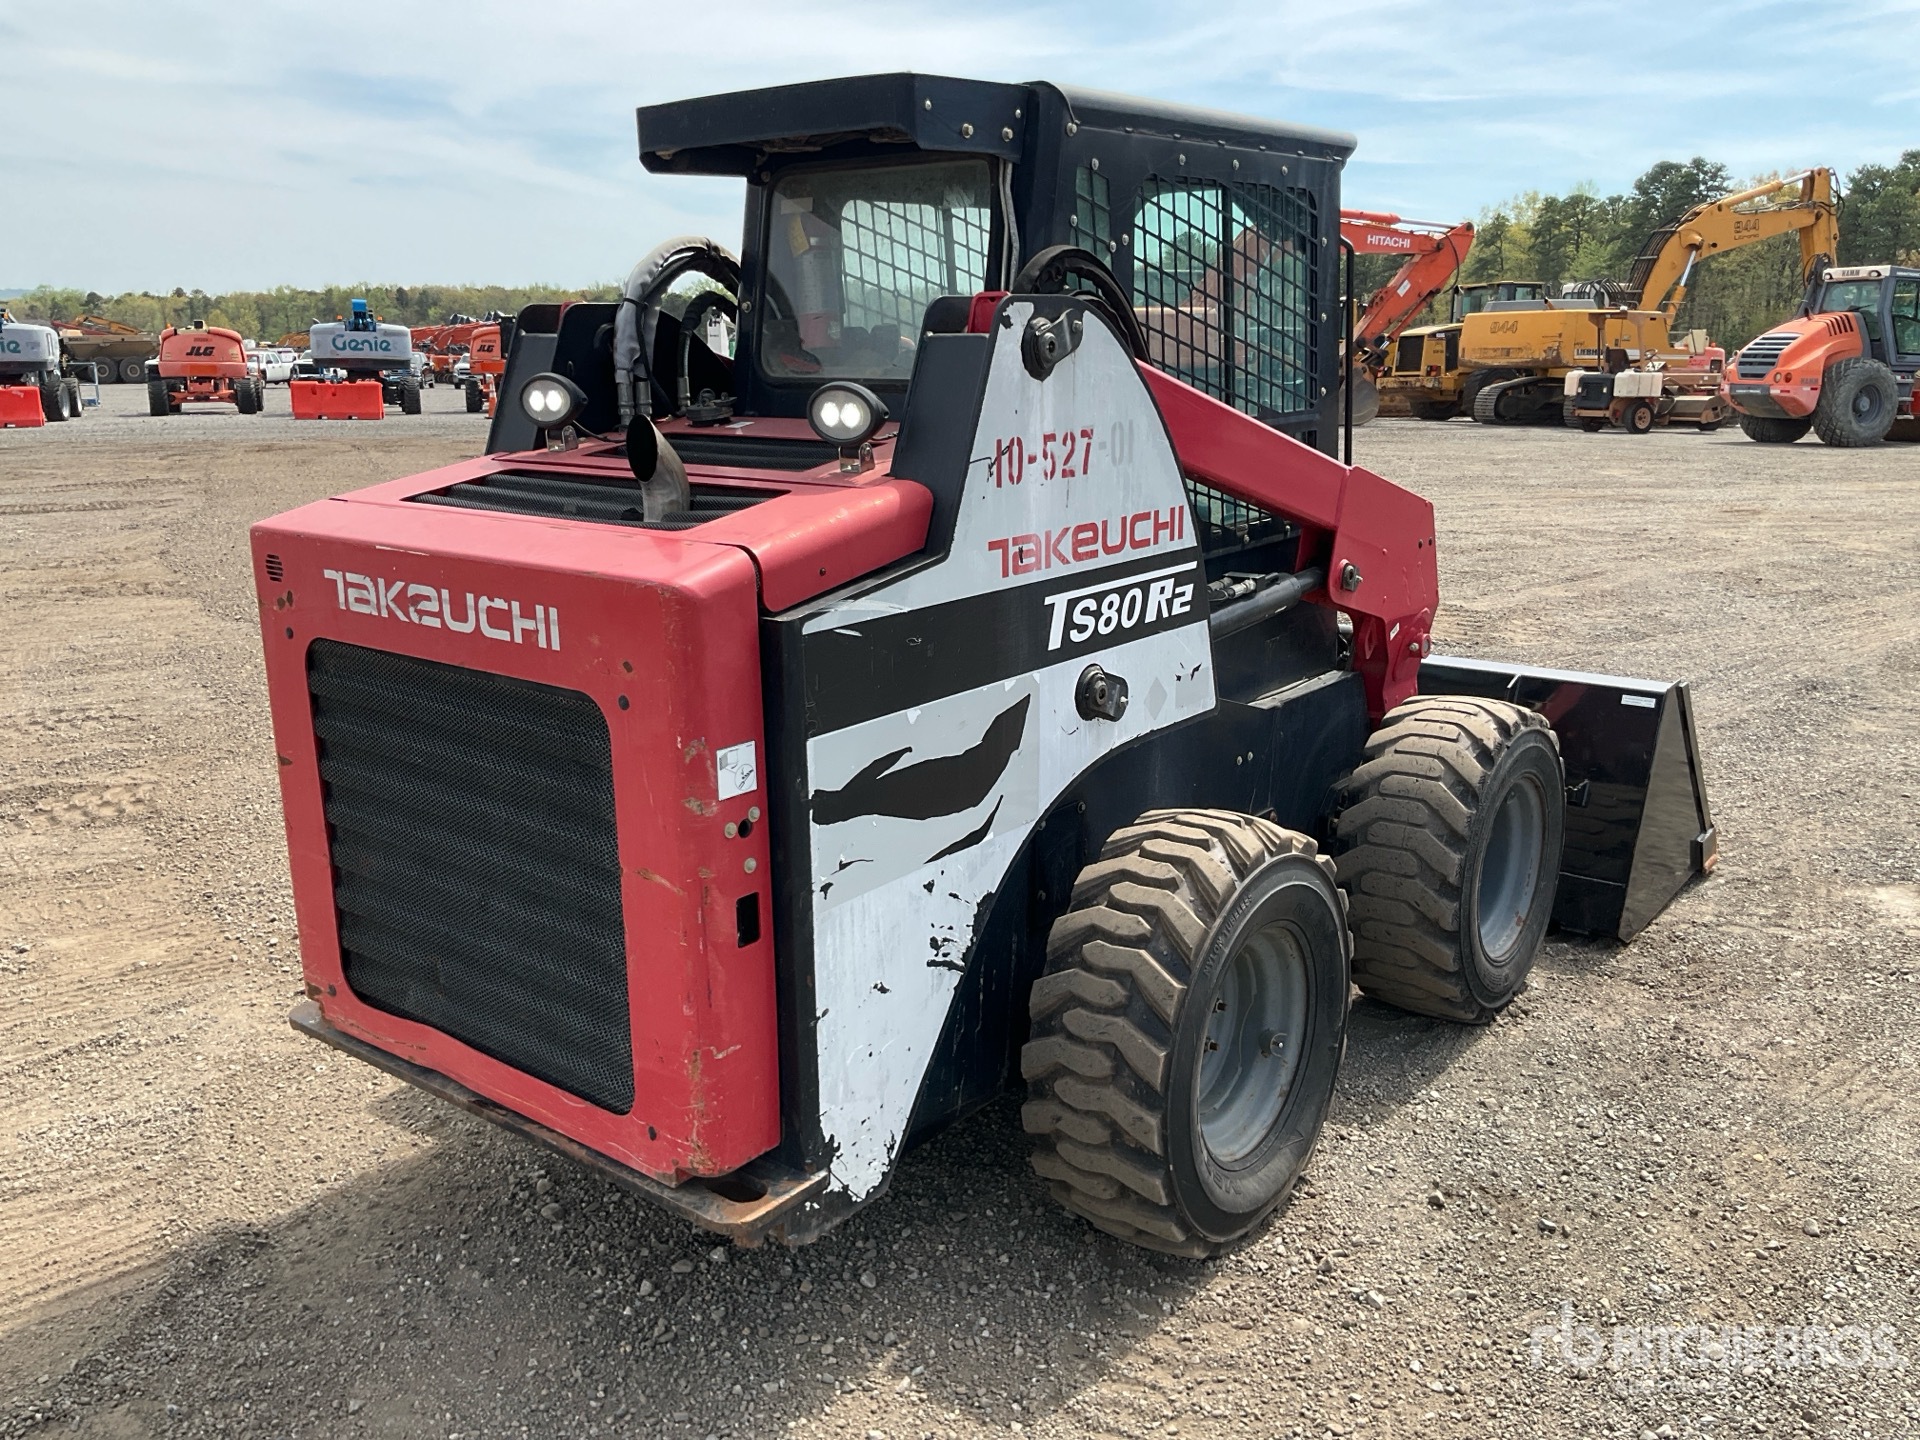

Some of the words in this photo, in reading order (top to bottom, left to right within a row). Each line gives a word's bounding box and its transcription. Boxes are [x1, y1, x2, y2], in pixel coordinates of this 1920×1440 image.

[1734, 219, 1760, 233] 944
[1366, 234, 1411, 249] HITACHI
[1489, 320, 1519, 334] 944
[331, 333, 392, 352] Genie
[476, 344, 495, 353] JLG
[185, 346, 216, 357] JLG
[987, 504, 1186, 579] TAKEUCHI
[323, 568, 562, 652] TAKEUCHI
